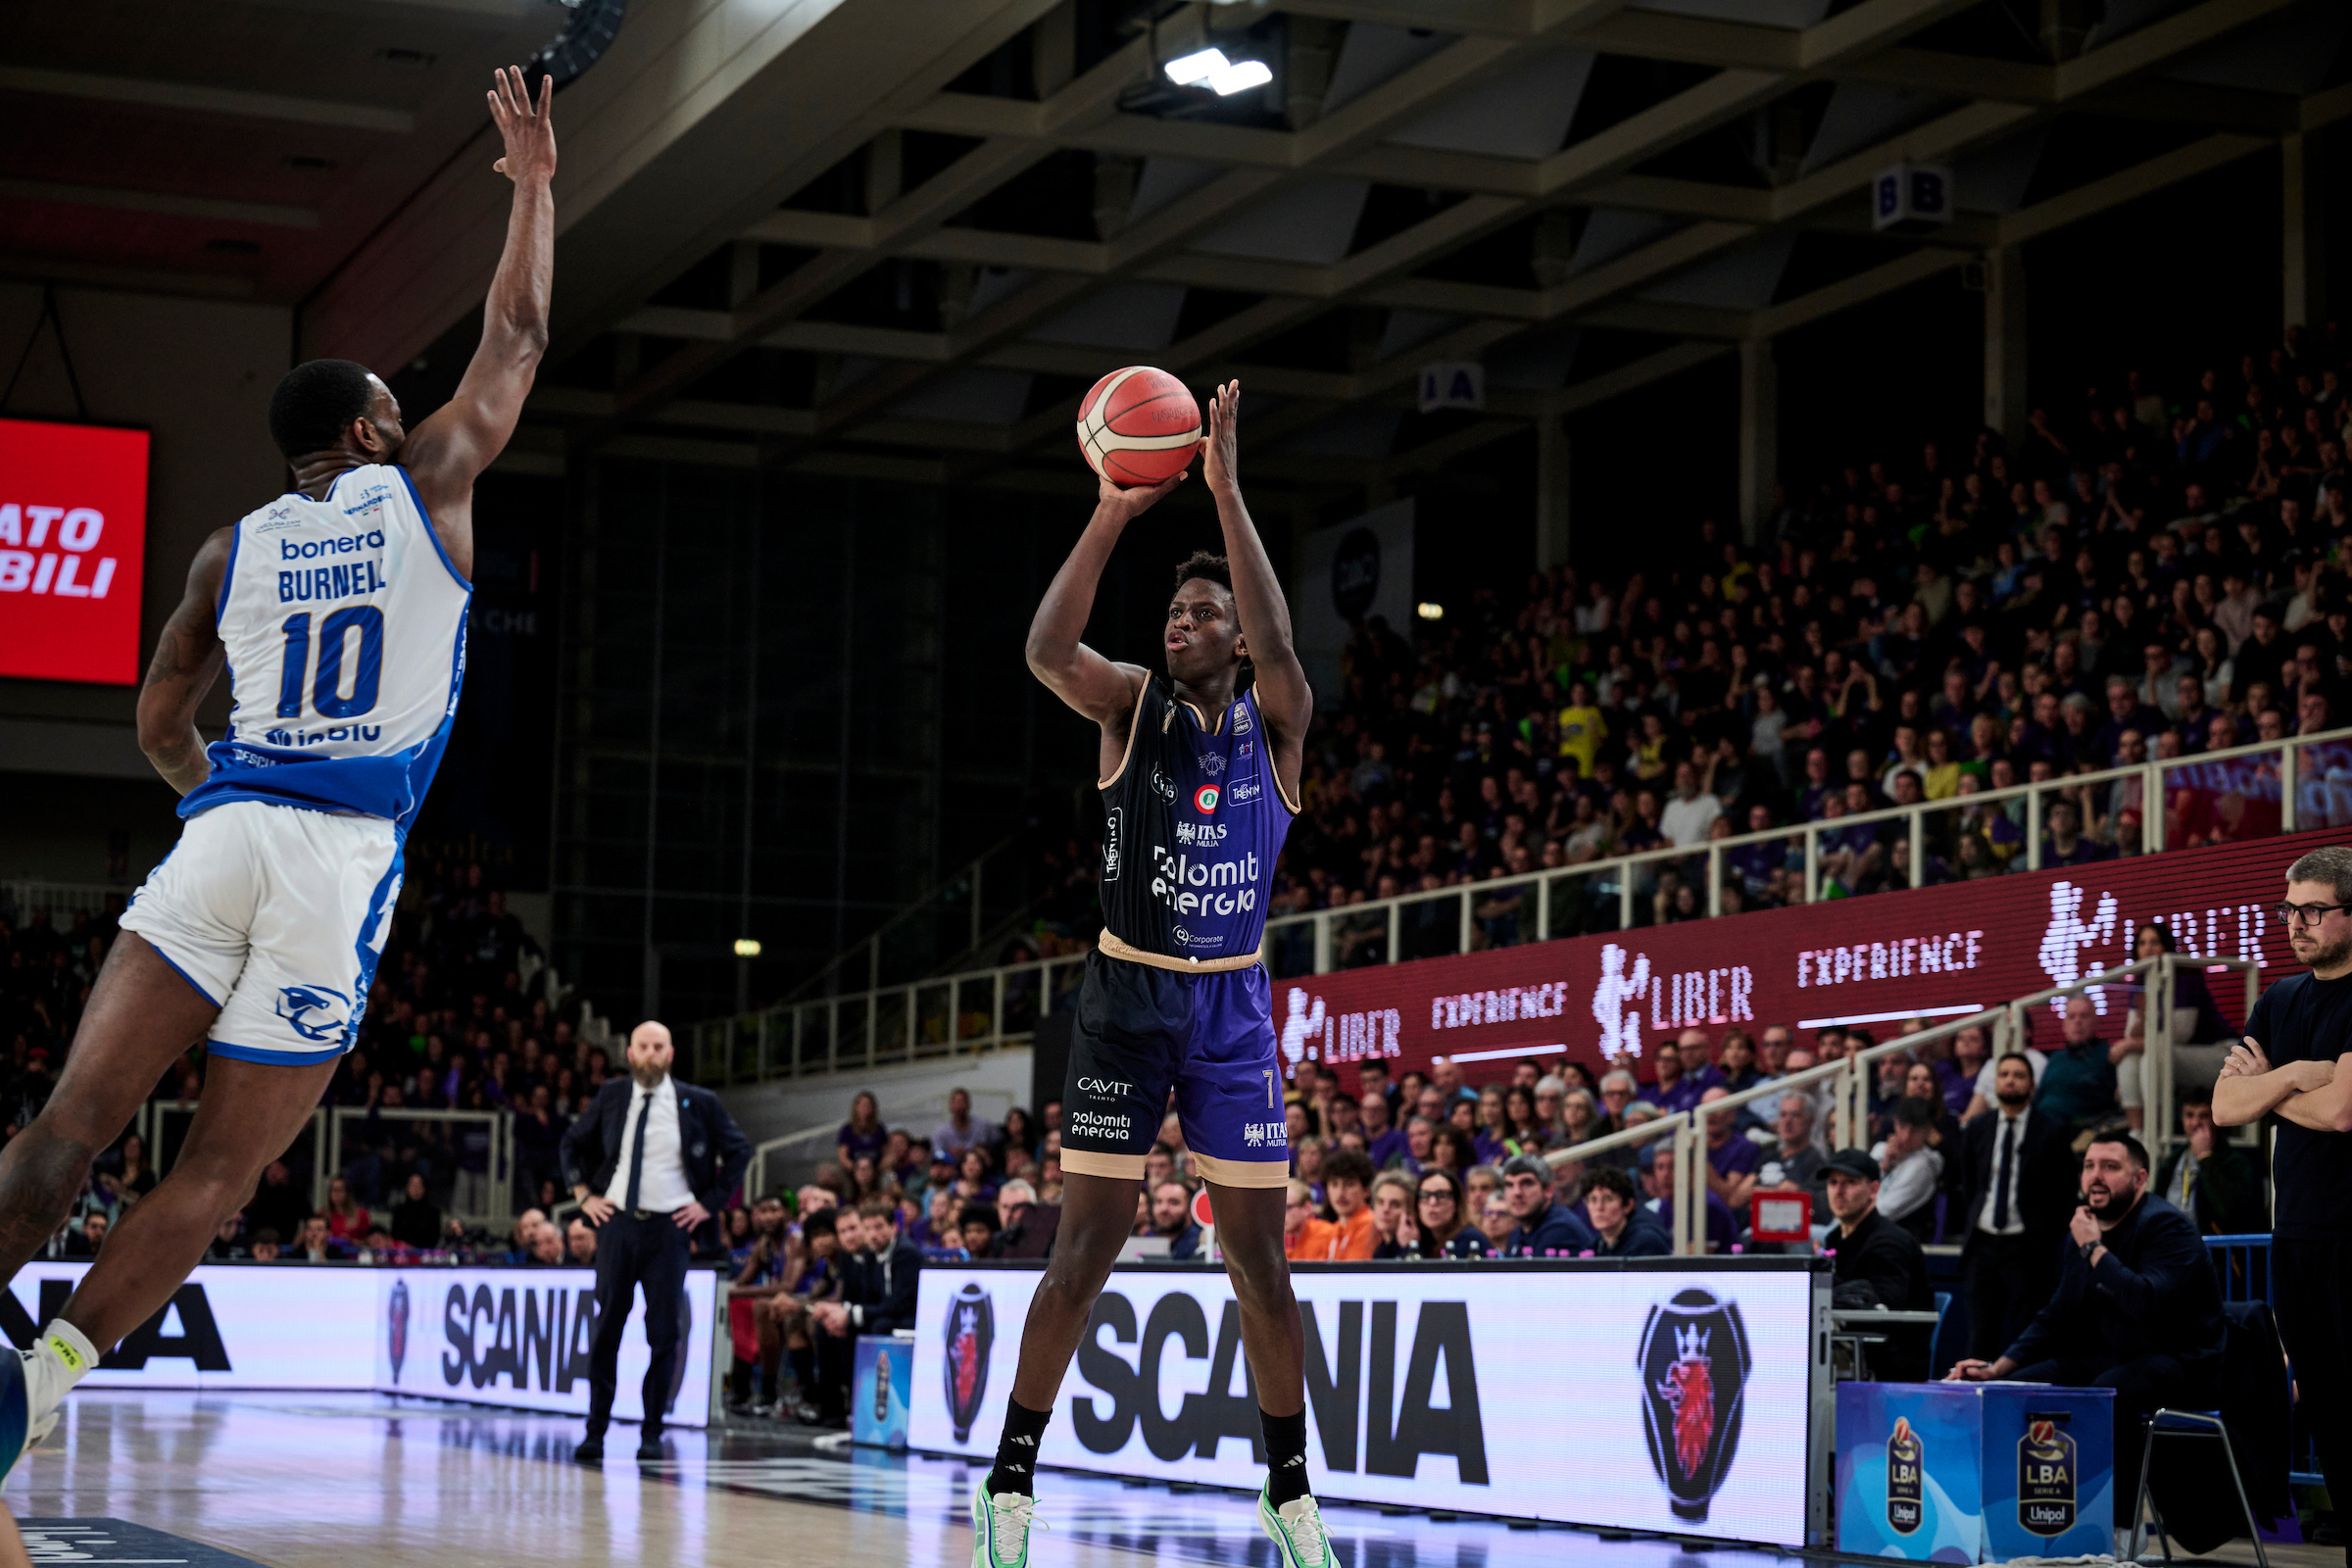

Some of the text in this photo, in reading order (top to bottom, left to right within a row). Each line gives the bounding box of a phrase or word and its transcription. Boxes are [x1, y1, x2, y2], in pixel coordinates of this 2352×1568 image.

[1911, 172, 1942, 213] B
[1449, 370, 1474, 400] A
[281, 529, 385, 561] bonera
[276, 604, 384, 719] 10
[1198, 823, 1228, 841] ITAS
[1189, 934, 1225, 945] Corporate
[1797, 929, 1985, 989] EXPERIENCE
[1077, 1076, 1133, 1096] CAVIT
[442, 1283, 594, 1395] SCANIA
[1072, 1291, 1490, 1487] SCANIA
[1892, 1464, 1918, 1485] LBA
[2026, 1464, 2070, 1485] LBA
[2030, 1505, 2066, 1526] Unipol
